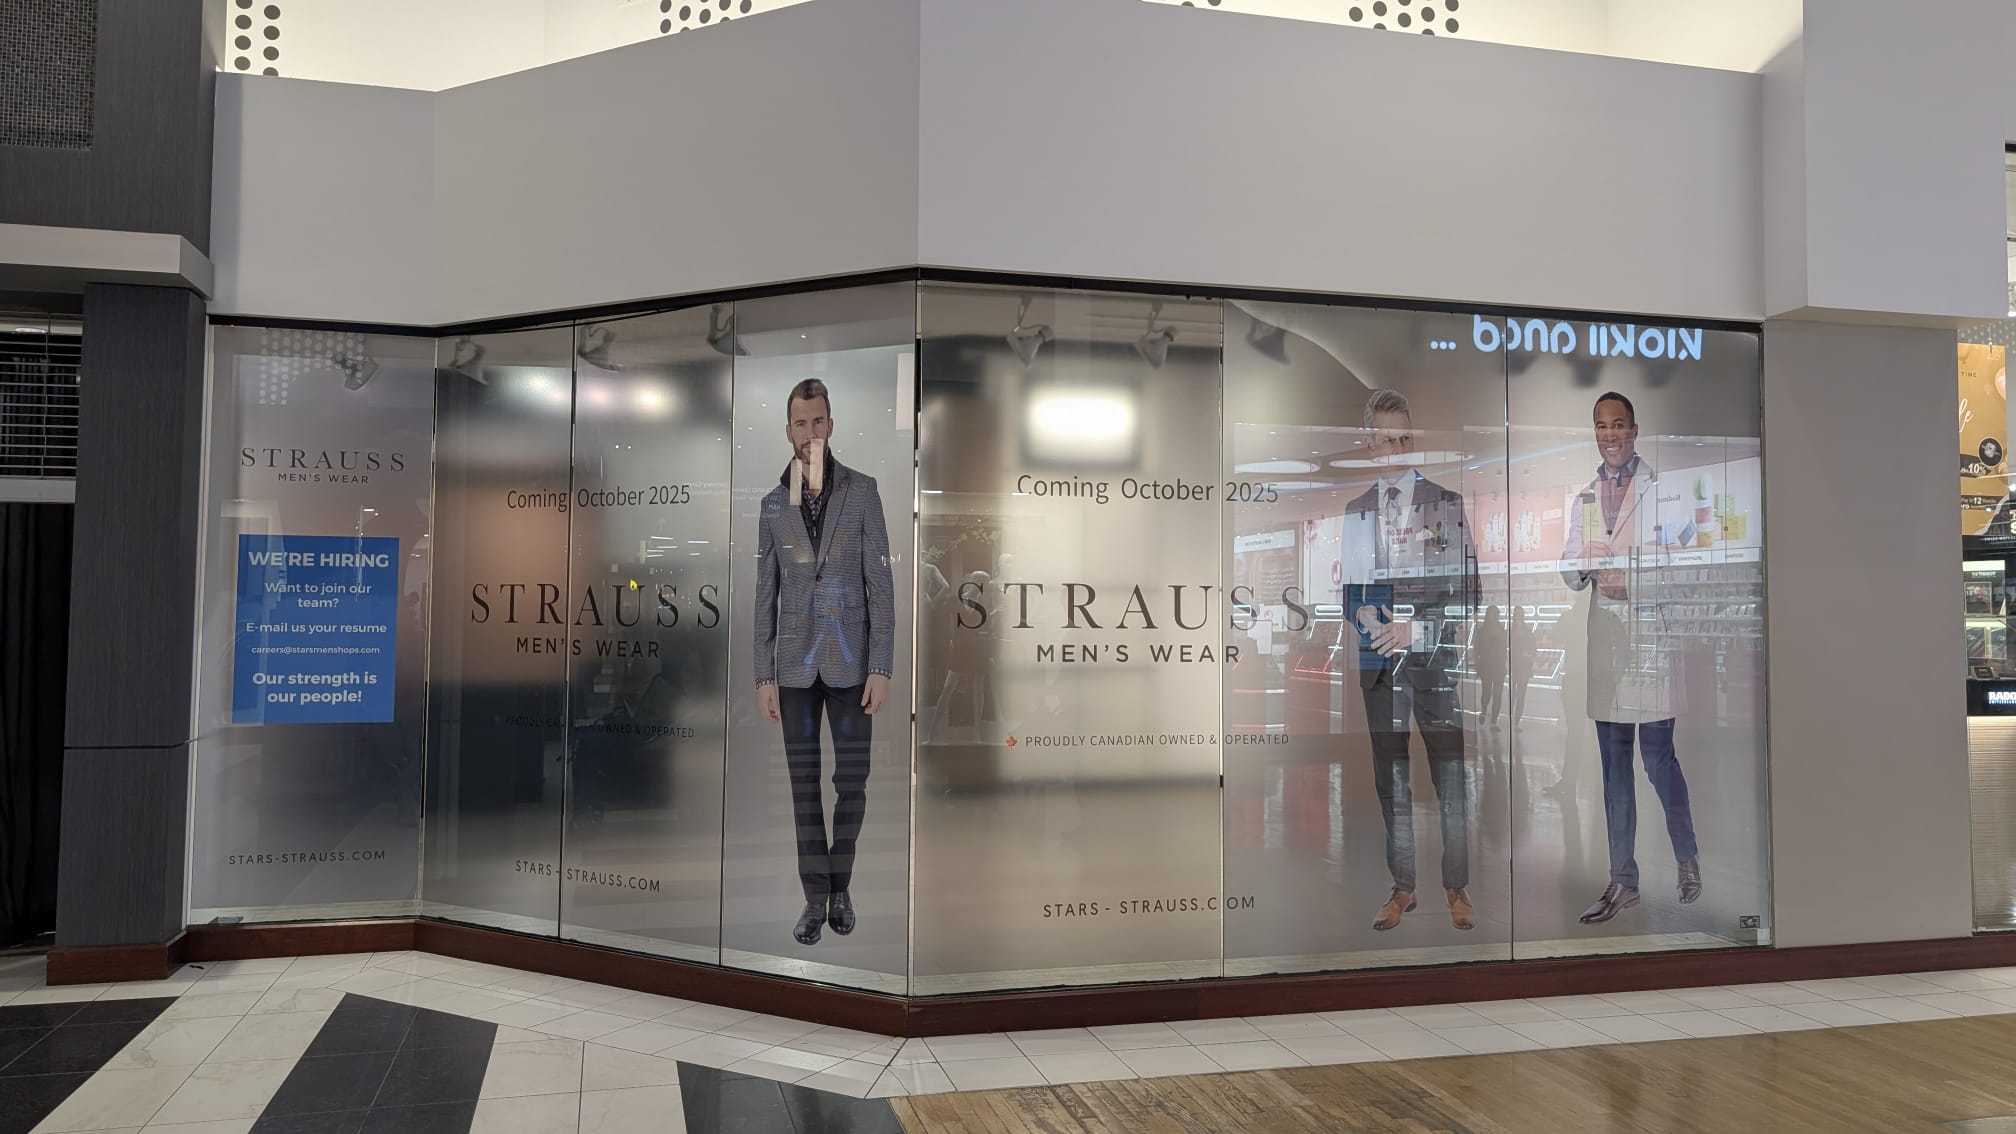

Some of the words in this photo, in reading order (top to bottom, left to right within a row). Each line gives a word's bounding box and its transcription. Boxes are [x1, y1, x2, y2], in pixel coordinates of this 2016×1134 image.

[241, 447, 404, 472] STRAUSS
[278, 473, 321, 482] MEN'S
[329, 474, 369, 483] WEAR
[1017, 474, 1109, 504] Coming
[1121, 477, 1215, 501] October
[1225, 481, 1279, 503] 2025
[507, 488, 567, 512] Coming
[577, 485, 645, 508] October
[648, 484, 691, 505] 2025
[248, 552, 315, 566] WE'RE
[320, 553, 389, 568] HIRING
[264, 582, 301, 593] Want
[305, 583, 318, 593] to
[320, 583, 346, 596] join
[349, 585, 372, 594] our
[297, 598, 339, 608] team?
[471, 583, 720, 629] STRAUSS
[956, 581, 1309, 632] STRAUSS
[246, 622, 288, 633] E-mail
[291, 625, 305, 633] us
[308, 625, 337, 635] your
[340, 625, 387, 633] resume
[251, 646, 380, 655] careers@starsmenshops.com
[516, 637, 581, 656] MEN'S
[595, 639, 659, 658] WEAR
[1036, 644, 1129, 663] MEN'S
[1150, 644, 1240, 664] WEAR
[252, 672, 284, 684] Our
[288, 672, 360, 686] strength
[364, 672, 377, 684] is
[267, 692, 296, 703] our
[300, 690, 362, 705] people!
[644, 725, 695, 738] OPERATED
[1025, 735, 1086, 747] PROUDLY
[1090, 734, 1154, 747] CANADIAN
[1159, 734, 1205, 745] OWNED
[1209, 734, 1217, 745] &
[1224, 733, 1289, 745] OPERATED
[228, 850, 385, 865] STARS-STRAUSS.COM
